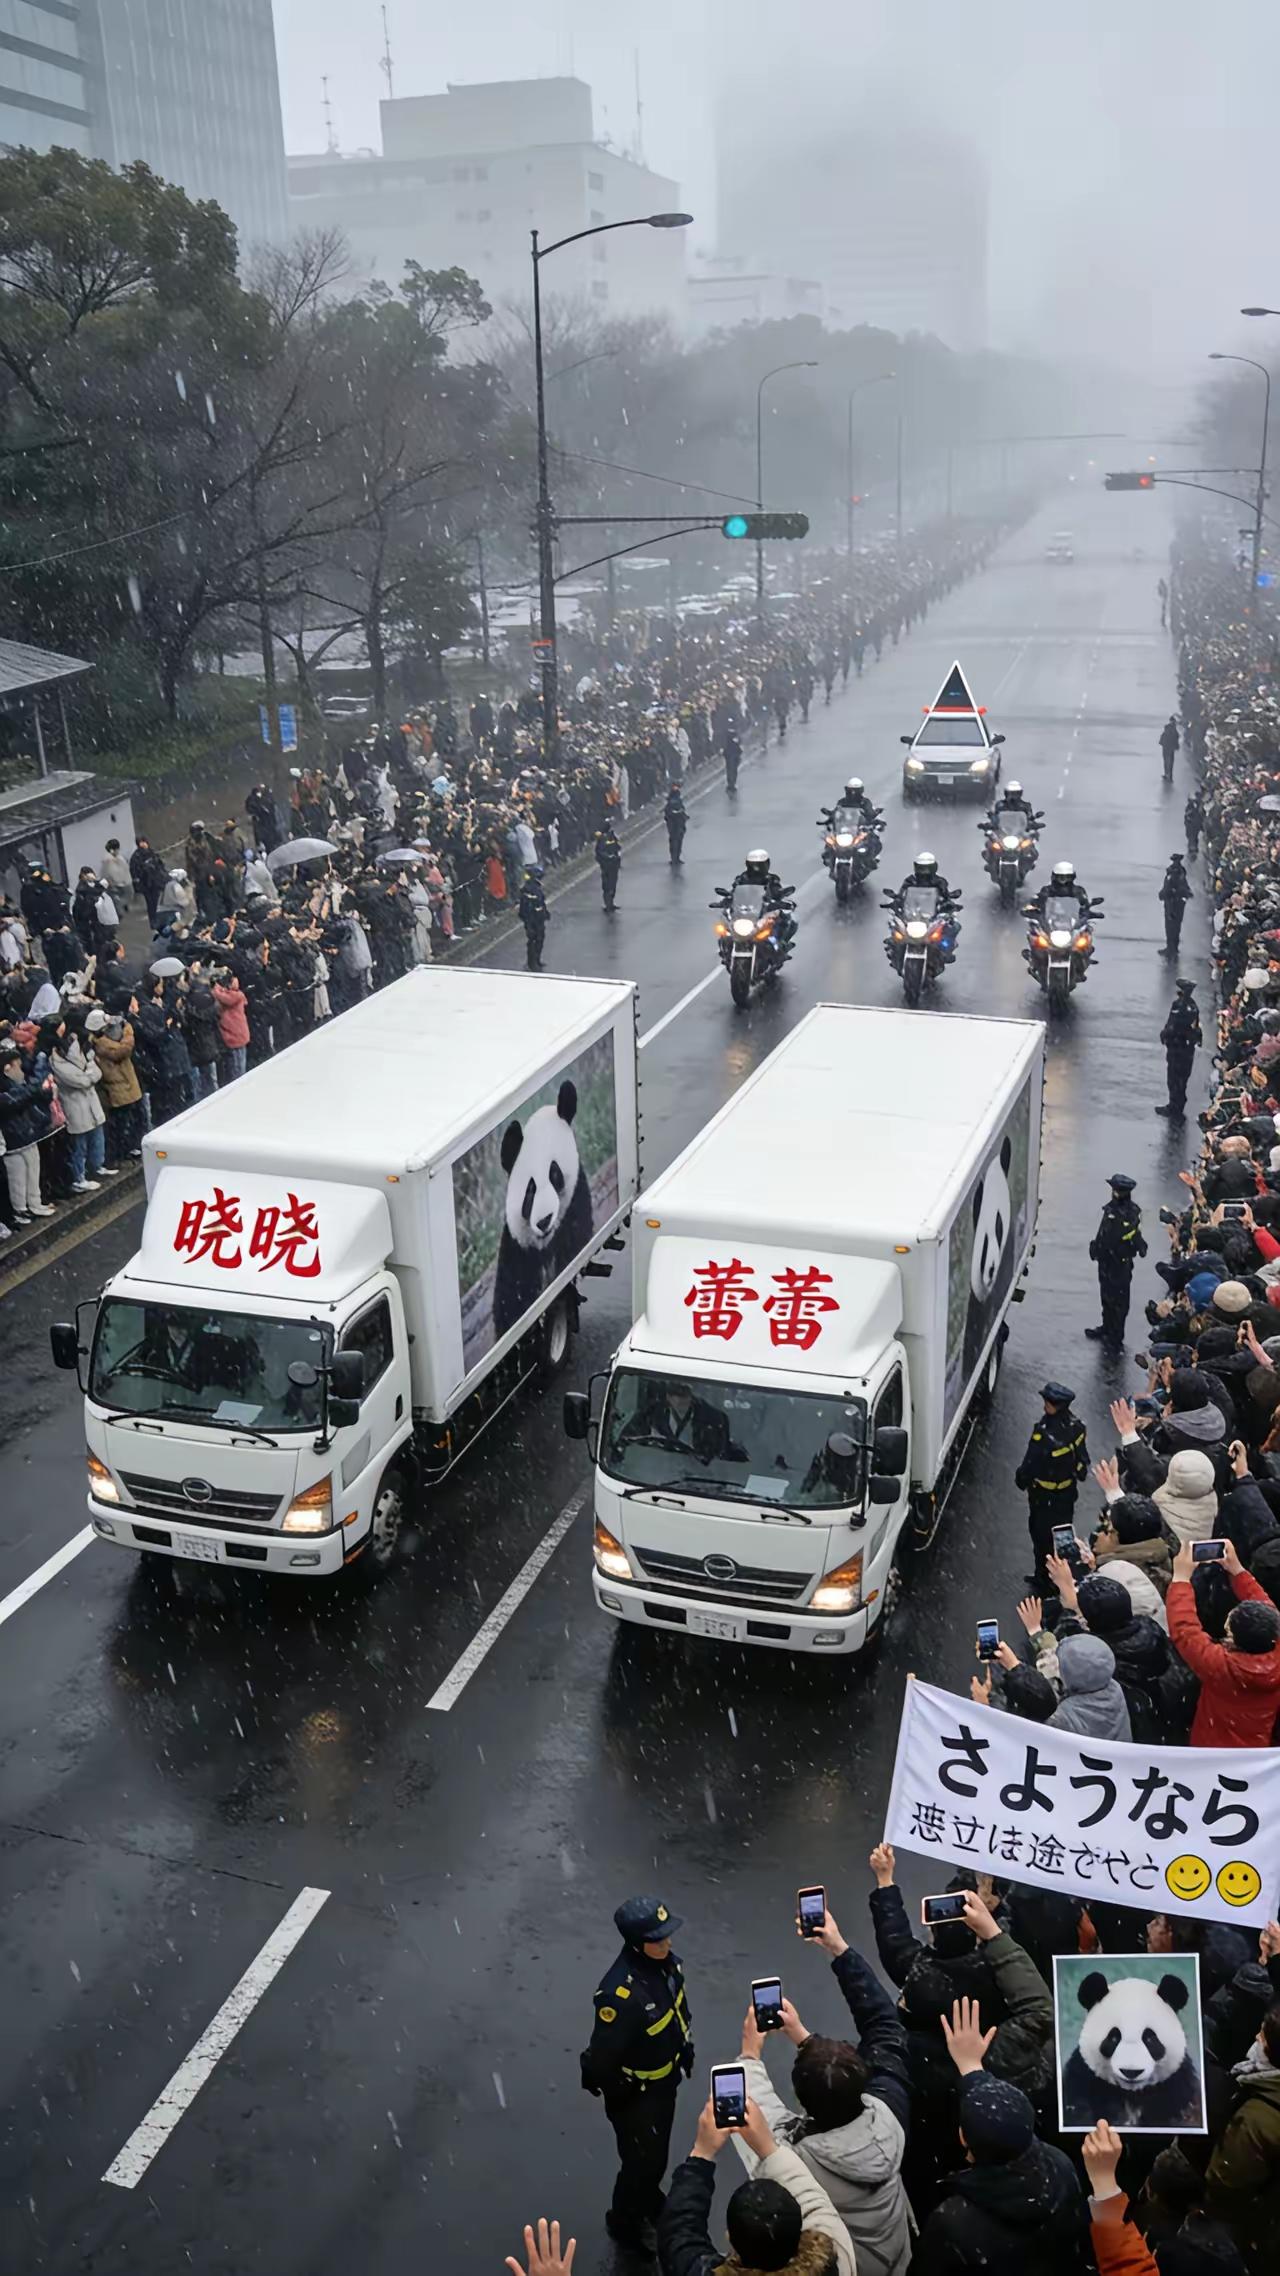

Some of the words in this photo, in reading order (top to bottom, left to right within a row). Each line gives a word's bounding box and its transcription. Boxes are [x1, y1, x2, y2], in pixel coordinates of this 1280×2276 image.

[173, 1187, 321, 1278] 晓晓
[683, 1257, 841, 1351] 蕾蕾
[938, 1724, 1260, 1847] さようなら
